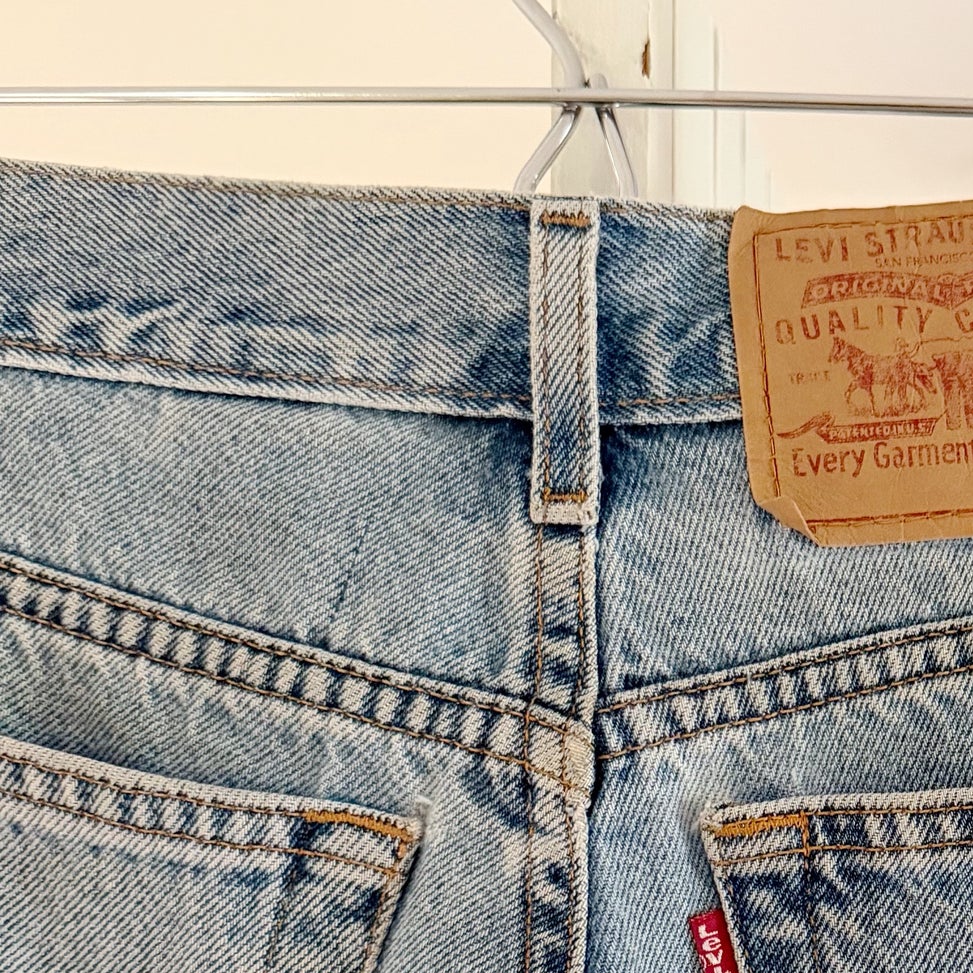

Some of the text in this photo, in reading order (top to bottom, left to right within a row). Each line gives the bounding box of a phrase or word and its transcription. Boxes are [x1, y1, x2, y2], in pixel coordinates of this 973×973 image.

[775, 236, 849, 263] LEVI
[874, 257, 902, 268] SAN
[810, 277, 946, 301] ORIGINAL
[775, 304, 933, 345] QUALITY
[792, 447, 866, 478] Every
